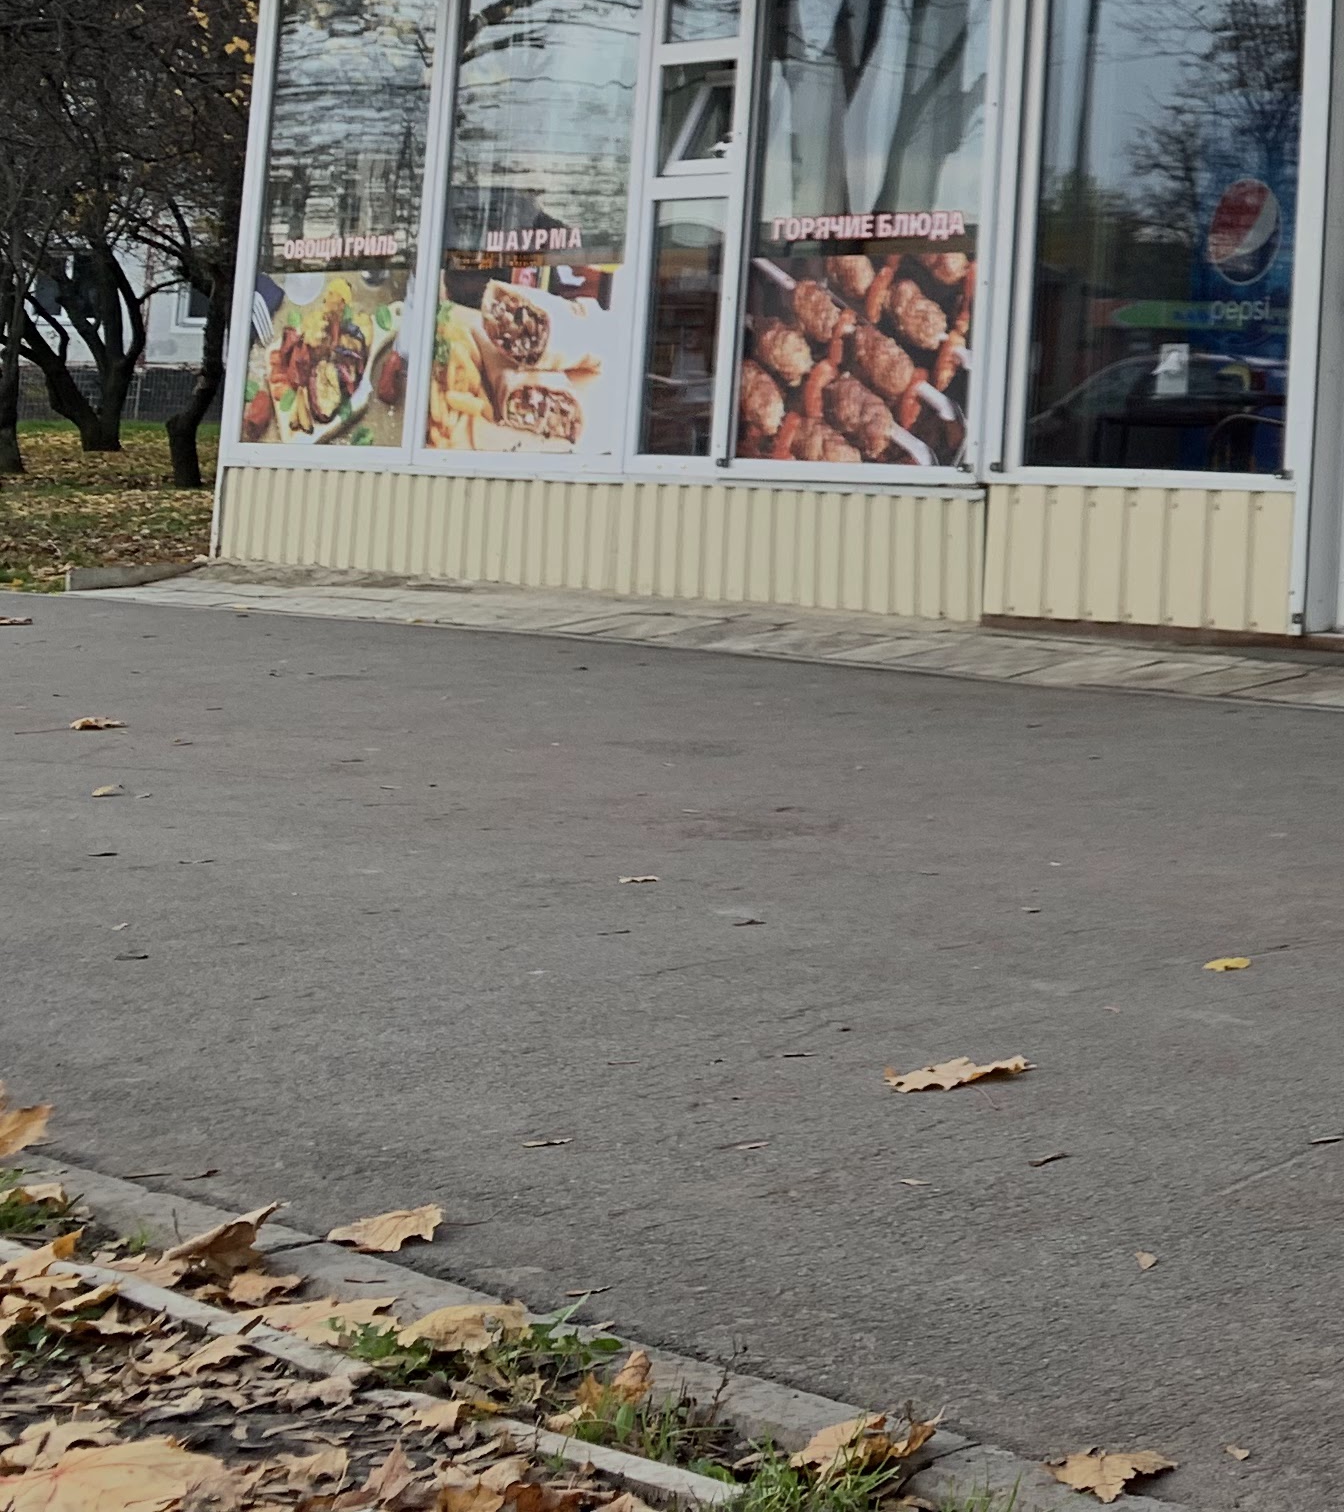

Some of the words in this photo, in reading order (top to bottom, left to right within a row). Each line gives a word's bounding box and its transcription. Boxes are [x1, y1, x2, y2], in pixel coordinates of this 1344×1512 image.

[486, 228, 582, 252] ШАУРМА
[772, 214, 873, 241] ГОРЯЧИЕ
[875, 211, 965, 241] БЛЮДА
[284, 238, 343, 262] ОВОЩИ
[344, 235, 398, 257] ГРИЛЬ
[1209, 296, 1271, 326] pepsi
